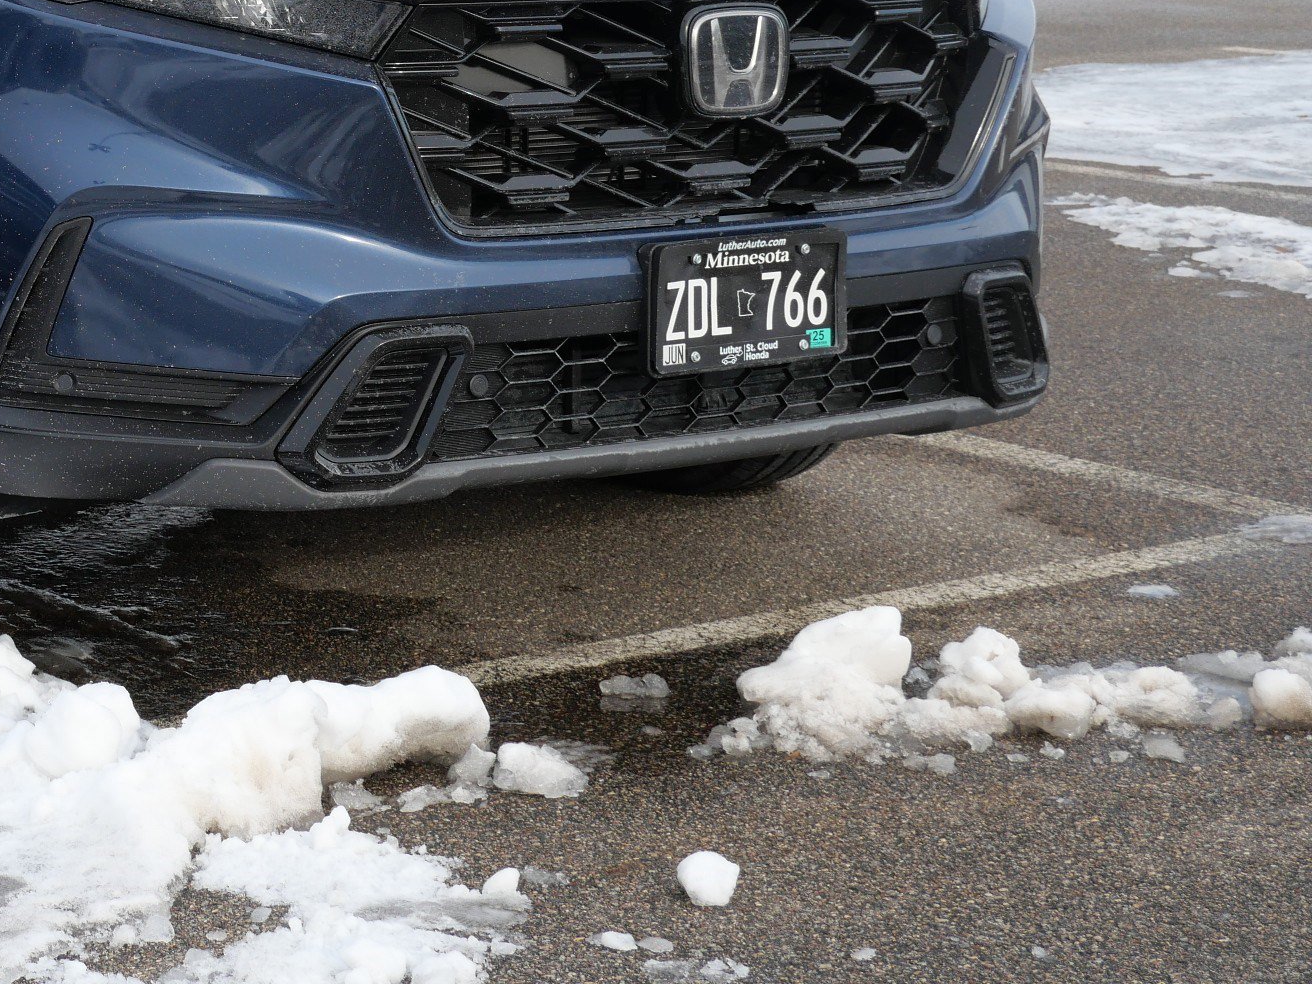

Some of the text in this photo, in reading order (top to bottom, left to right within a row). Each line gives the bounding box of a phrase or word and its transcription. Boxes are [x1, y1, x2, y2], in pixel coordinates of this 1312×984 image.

[718, 238, 786, 252] LutherAuto.com
[705, 249, 789, 268] Minnesota
[665, 268, 827, 341] ZDL 766
[719, 345, 743, 356] Luther
[746, 340, 778, 352] St. Cloud
[664, 345, 686, 365] JUN
[745, 350, 769, 361] Honda
